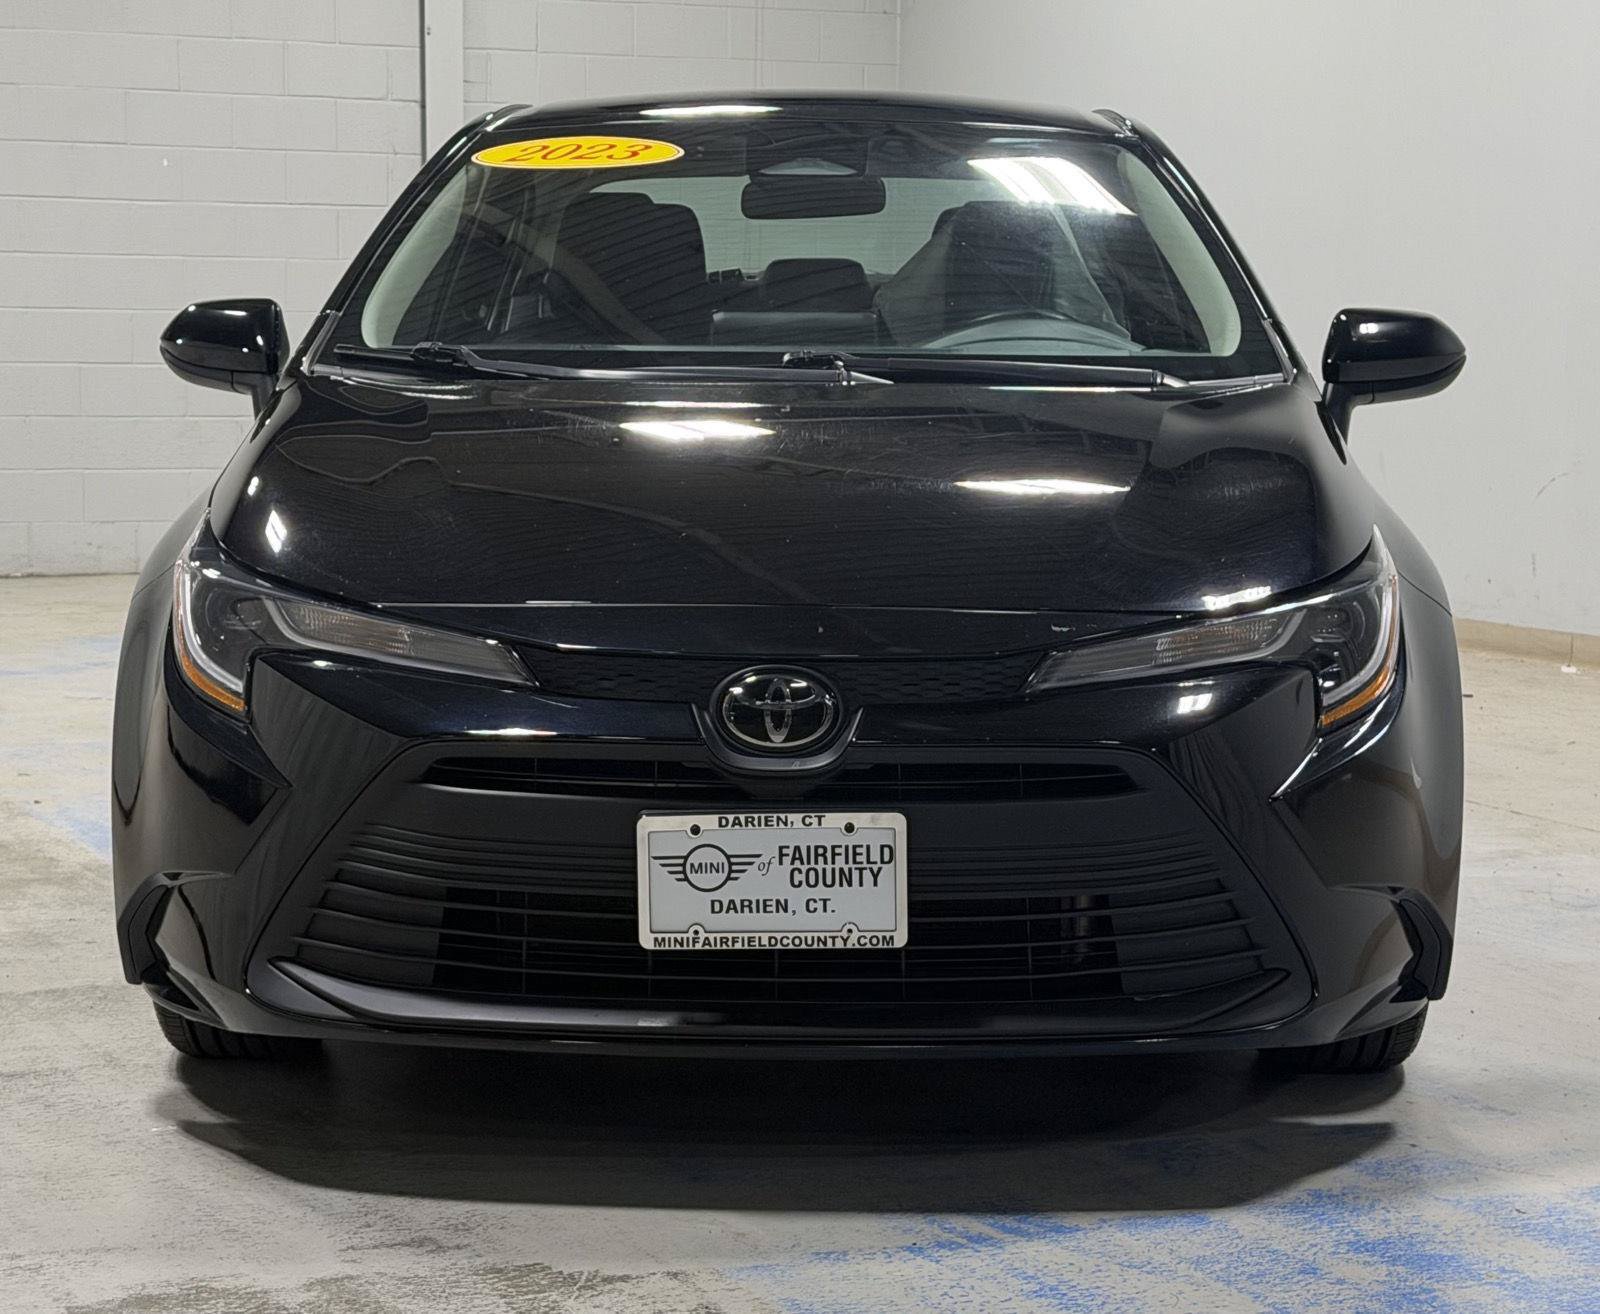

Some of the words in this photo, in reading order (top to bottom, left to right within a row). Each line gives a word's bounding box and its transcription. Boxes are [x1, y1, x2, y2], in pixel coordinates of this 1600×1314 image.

[503, 143, 652, 162] 2023
[718, 815, 794, 829] DARIEN,
[801, 814, 826, 827] CT
[690, 862, 725, 874] MINI
[757, 856, 776, 876] of
[778, 844, 894, 866] FAIRFIELD
[789, 866, 883, 888] COUNTY
[710, 899, 796, 916] DARIEN,
[805, 898, 836, 914] CT.
[653, 934, 895, 948] MINIFAIRFIELDCOUNTY.COM
